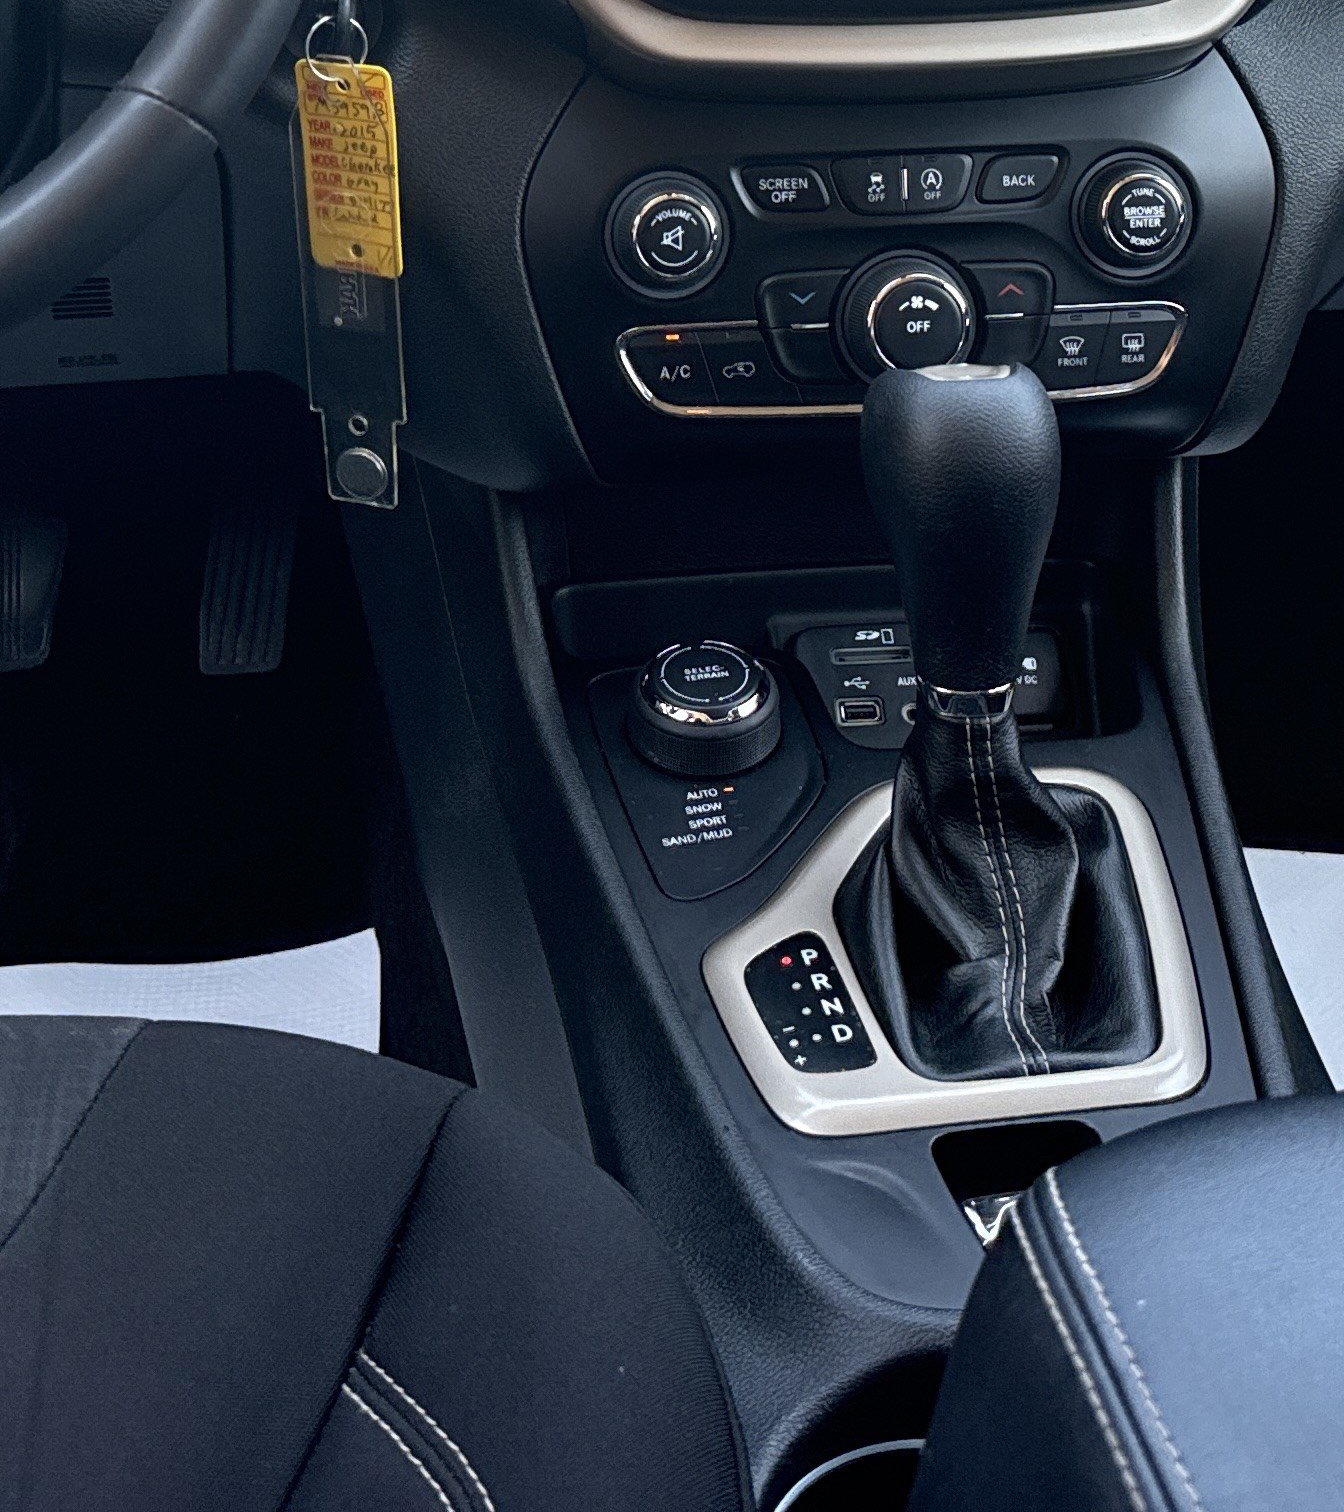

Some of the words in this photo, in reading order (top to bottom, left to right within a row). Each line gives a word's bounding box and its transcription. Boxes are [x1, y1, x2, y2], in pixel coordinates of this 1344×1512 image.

[758, 177, 809, 190] SCREEN
[1002, 174, 1036, 187] BACK
[771, 191, 798, 203] OFF
[866, 192, 886, 203] OFF
[923, 190, 942, 201] OFF
[1131, 187, 1155, 197] TUNE
[655, 208, 692, 222] VOLUME
[1123, 204, 1166, 217] BROWSE
[1129, 217, 1162, 229] ENTER
[1129, 234, 1162, 247] SCROLL
[906, 320, 932, 333] OFF
[1057, 356, 1089, 368] FRONT
[1121, 353, 1145, 364] REAR
[659, 363, 692, 383] A/C
[684, 670, 730, 682] TERRAIN
[897, 674, 919, 687] AUX
[686, 787, 719, 801] AUTO
[684, 801, 723, 816] SNOW
[688, 814, 728, 829] SPORT
[661, 827, 733, 847] SAND/MUD
[800, 948, 818, 967] P
[810, 972, 833, 991] R
[820, 996, 845, 1016] N
[830, 1023, 854, 1043] D
